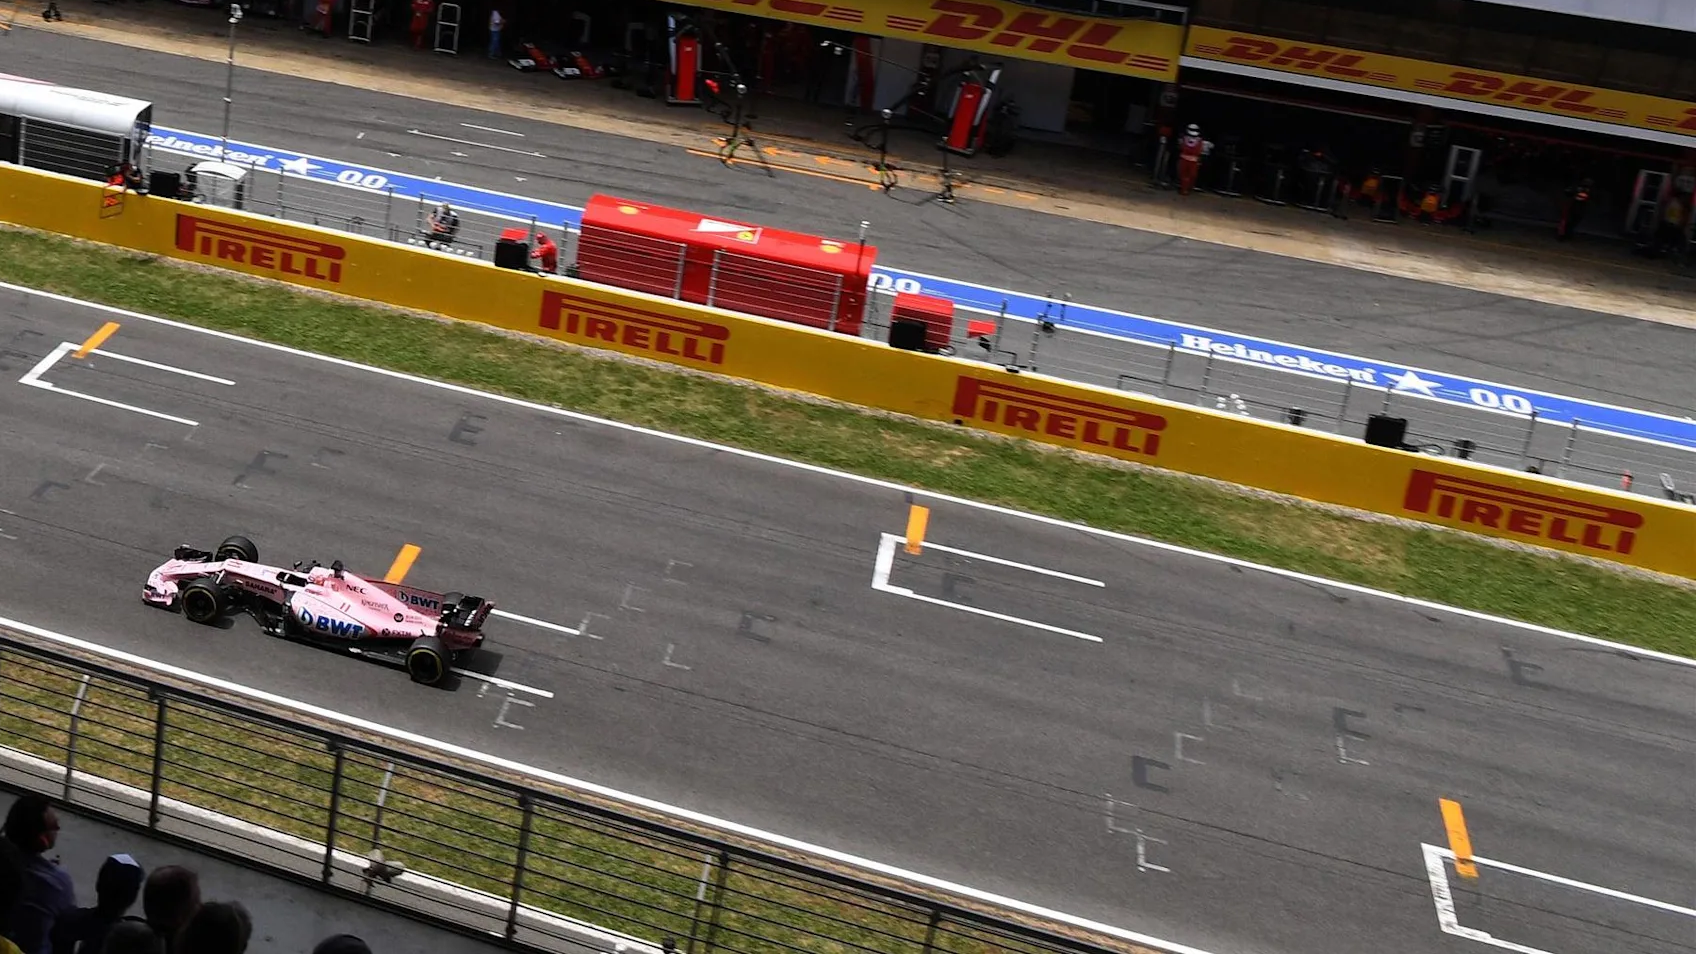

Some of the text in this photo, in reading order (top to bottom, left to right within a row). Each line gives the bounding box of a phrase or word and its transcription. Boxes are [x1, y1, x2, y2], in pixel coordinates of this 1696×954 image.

[1221, 36, 1369, 79] DHL
[1443, 71, 1599, 113] DHL
[145, 133, 271, 167] eineken
[175, 213, 346, 284] PIRELLI
[539, 290, 731, 365] PIRELLI
[1179, 332, 1377, 385] Heineken
[952, 374, 1168, 457] PIRELLI
[1402, 468, 1646, 556] PIRELLI
[346, 583, 369, 595] NEC
[410, 595, 440, 610] BWT
[315, 615, 364, 639] BWT
